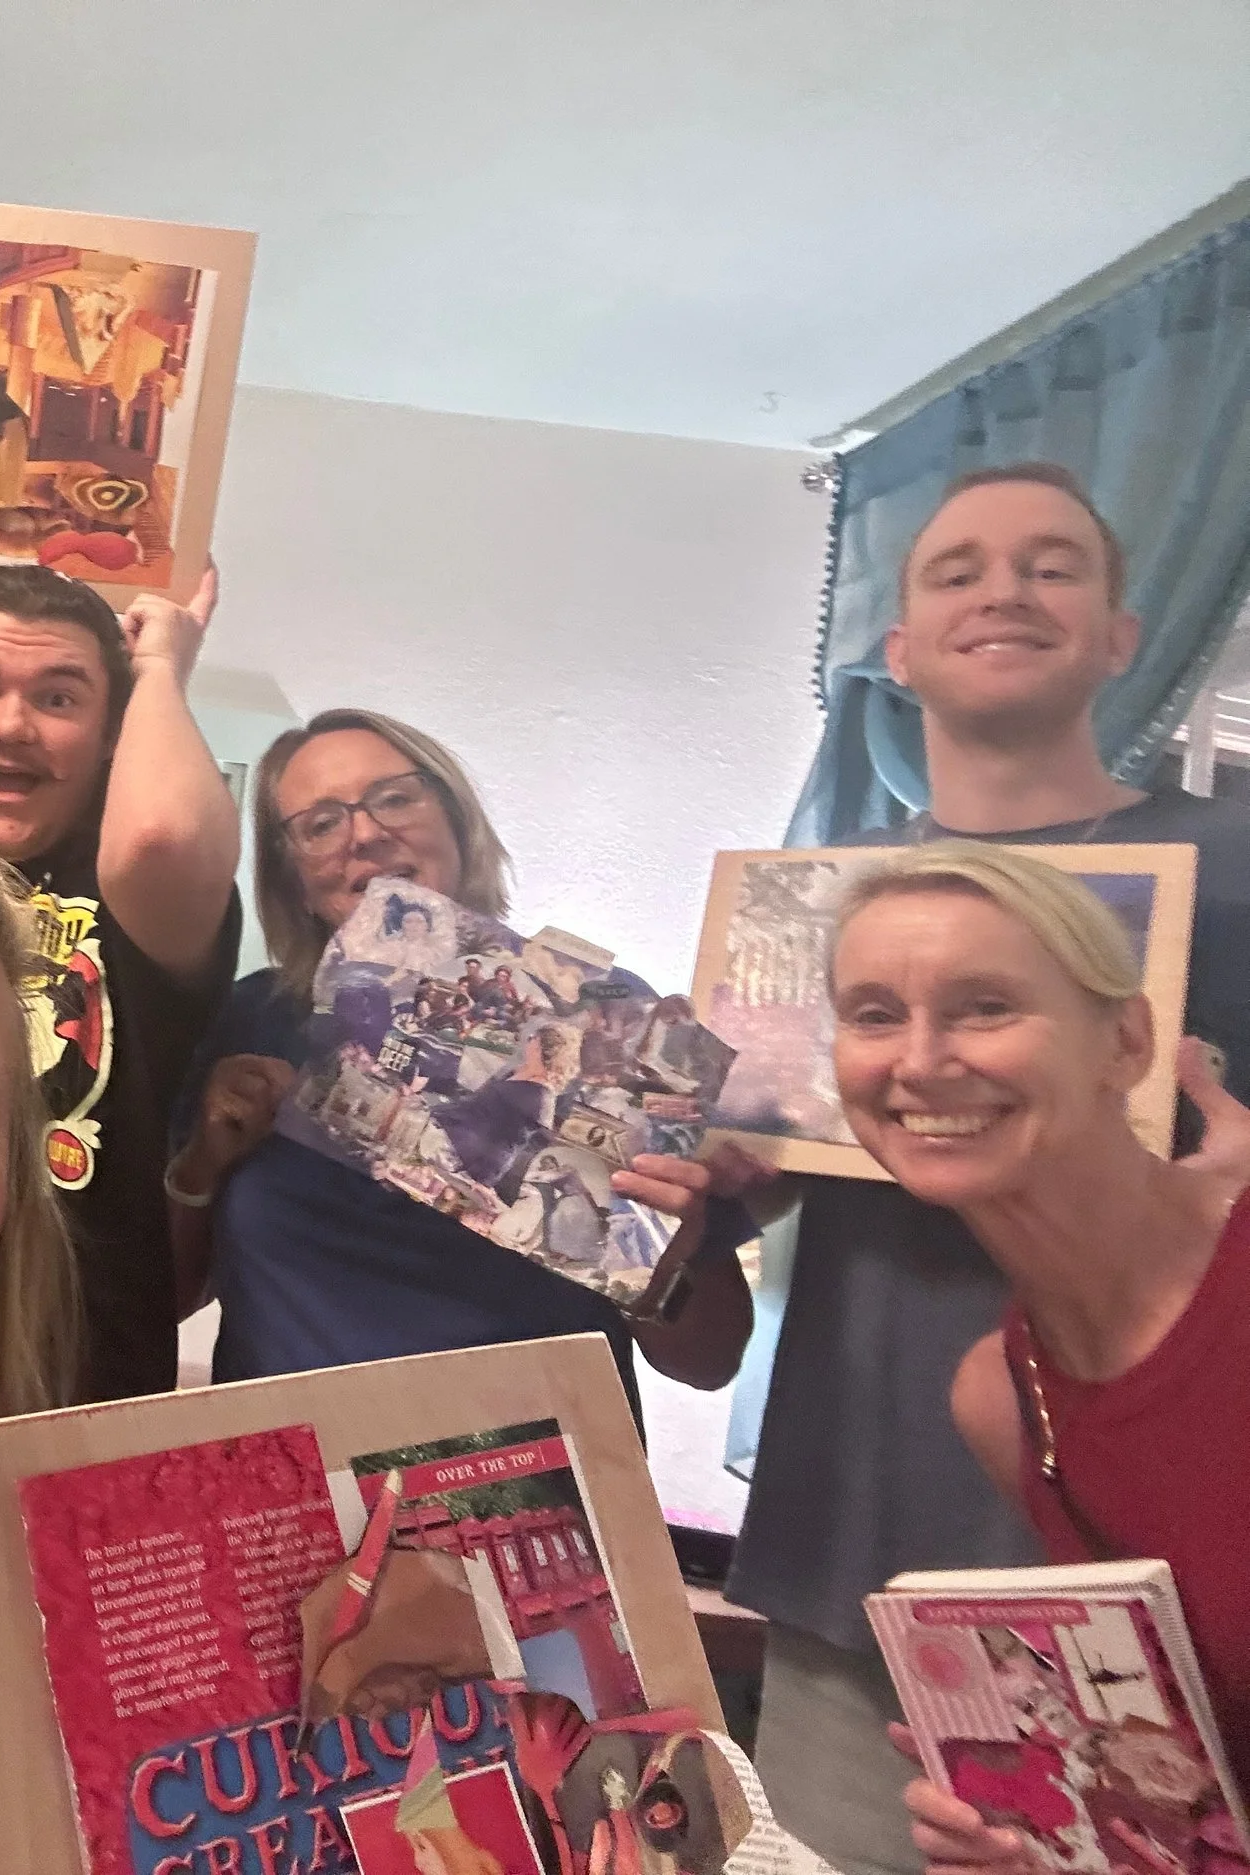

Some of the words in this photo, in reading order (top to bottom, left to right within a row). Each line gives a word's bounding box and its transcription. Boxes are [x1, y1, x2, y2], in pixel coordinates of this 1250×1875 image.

[435, 1464, 475, 1483] OVER
[478, 1456, 507, 1474] THE
[509, 1451, 536, 1468] TOP
[127, 1540, 138, 1551] of
[227, 1534, 243, 1547] the
[262, 1526, 273, 1539] of
[88, 1567, 104, 1579] are
[105, 1556, 144, 1574] brought
[145, 1554, 155, 1565] in
[157, 1548, 181, 1562] each
[182, 1543, 204, 1556] year
[91, 1584, 106, 1596] on
[106, 1578, 131, 1591] large
[133, 1571, 162, 1586] trucks
[163, 1564, 188, 1578] from
[188, 1560, 207, 1572] the
[156, 1583, 188, 1599] region
[190, 1577, 201, 1590] of
[130, 1607, 161, 1621] where
[162, 1601, 181, 1615] the
[182, 1595, 203, 1609] fruit
[101, 1637, 111, 1648] is
[154, 1612, 211, 1634] Participants
[105, 1652, 122, 1666] are
[123, 1635, 181, 1661] encouraged
[182, 1634, 194, 1646] to
[195, 1628, 220, 1641] wear
[109, 1662, 158, 1685] protective
[160, 1651, 200, 1672] goggles
[201, 1643, 220, 1660] and
[112, 1685, 146, 1705] gloves
[147, 1676, 167, 1691] and
[169, 1669, 194, 1685] must
[195, 1660, 230, 1680] squash
[115, 1704, 134, 1718] the
[135, 1692, 182, 1713] tomatoes
[183, 1683, 217, 1701] before
[131, 1680, 510, 1838] CURIOU
